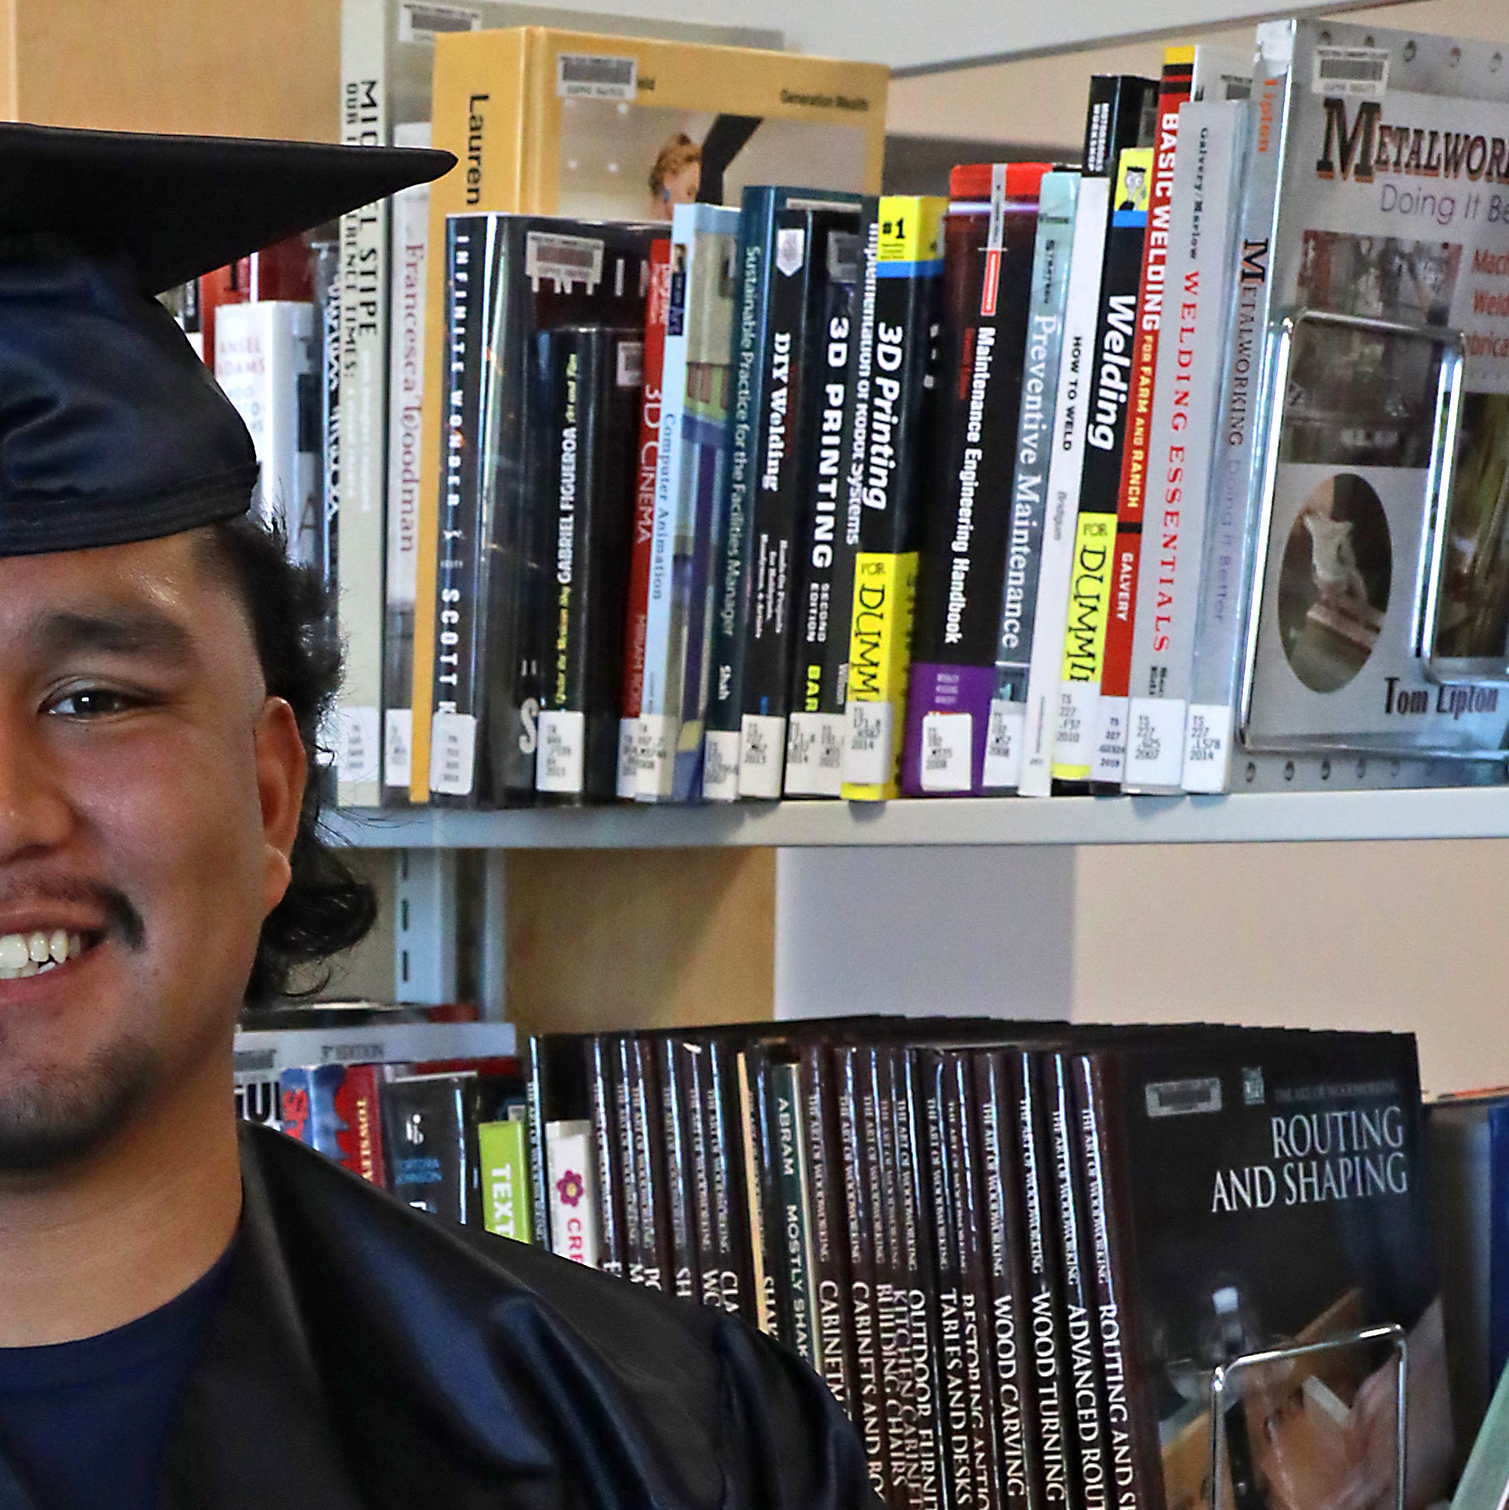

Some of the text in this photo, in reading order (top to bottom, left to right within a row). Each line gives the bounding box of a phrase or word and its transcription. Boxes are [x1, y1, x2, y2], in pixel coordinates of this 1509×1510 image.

[344, 82, 358, 132] OUR
[466, 94, 490, 205] Lauren
[1257, 78, 1278, 154] Lipton
[1316, 97, 1509, 184] METALWOR
[1189, 127, 1209, 260] Galvery/Marlow
[1380, 183, 1455, 225] Doing
[1465, 193, 1481, 220] It
[357, 247, 378, 337] STIPE
[858, 223, 879, 377] Implementation
[1069, 336, 1082, 373] HOW
[1172, 270, 1200, 432] WELDING
[1228, 238, 1269, 446] METALWORKING
[400, 243, 424, 553] Francesca Woodman
[447, 235, 470, 506] INFINITE WONDER
[644, 384, 661, 428] 3D
[762, 332, 792, 491] DIY Welding
[862, 321, 903, 510] 3D Printing
[966, 327, 995, 443] Maintenance
[1062, 406, 1076, 451] WELD
[1067, 379, 1078, 400] TO
[1088, 294, 1136, 451] Welding
[1116, 113, 1180, 622] BASIC WELDING FOR FARM AND RANCH GALVERY
[556, 427, 577, 585] GABRIEL FIGUEROA
[637, 441, 659, 545] CINEMA
[652, 414, 676, 600] Computer Animation
[717, 246, 761, 700] Sustainable Practice for the Facilities Manager Shah
[813, 316, 850, 569] 3D PRINTING
[951, 447, 984, 552] Engineering
[1002, 314, 1057, 649] Preventive Maintenance
[1221, 459, 1241, 526] Doing
[945, 557, 971, 644] Handbook
[1067, 545, 1107, 682] DUMMI
[1152, 445, 1186, 653] ESSENTIALS
[1213, 554, 1232, 622] Better
[440, 588, 461, 686] SCOTT
[850, 583, 887, 701] DUMM
[1384, 677, 1499, 721] Tom Lipton
[982, 1102, 1004, 1277] THE ART OF WOODWORKING
[1020, 1098, 1044, 1275] THE ART OF WOODWORKING
[1052, 1110, 1080, 1285] THE ART OF WOODWORKING
[1080, 1108, 1108, 1284] THE ART OF WOODWORKING
[1211, 1152, 1409, 1213] AND SHAPING
[1271, 1105, 1404, 1159] ROUTING
[776, 1097, 810, 1361] ABRAM MOSTLY SHAK
[818, 1280, 844, 1401] CABINETM
[851, 1281, 882, 1455] CABINETS AND
[909, 1289, 933, 1418] OUTDOOR
[939, 1288, 973, 1505] TABLES AND DESKS
[993, 1295, 1026, 1496] WOOD CARVING
[1030, 1291, 1065, 1502] WOOD TURNING
[1067, 1303, 1099, 1442] ADVANCED
[1098, 1303, 1129, 1423] ROUTING
[884, 1399, 908, 1486] CHAIRS
[1110, 1429, 1134, 1486] AND
